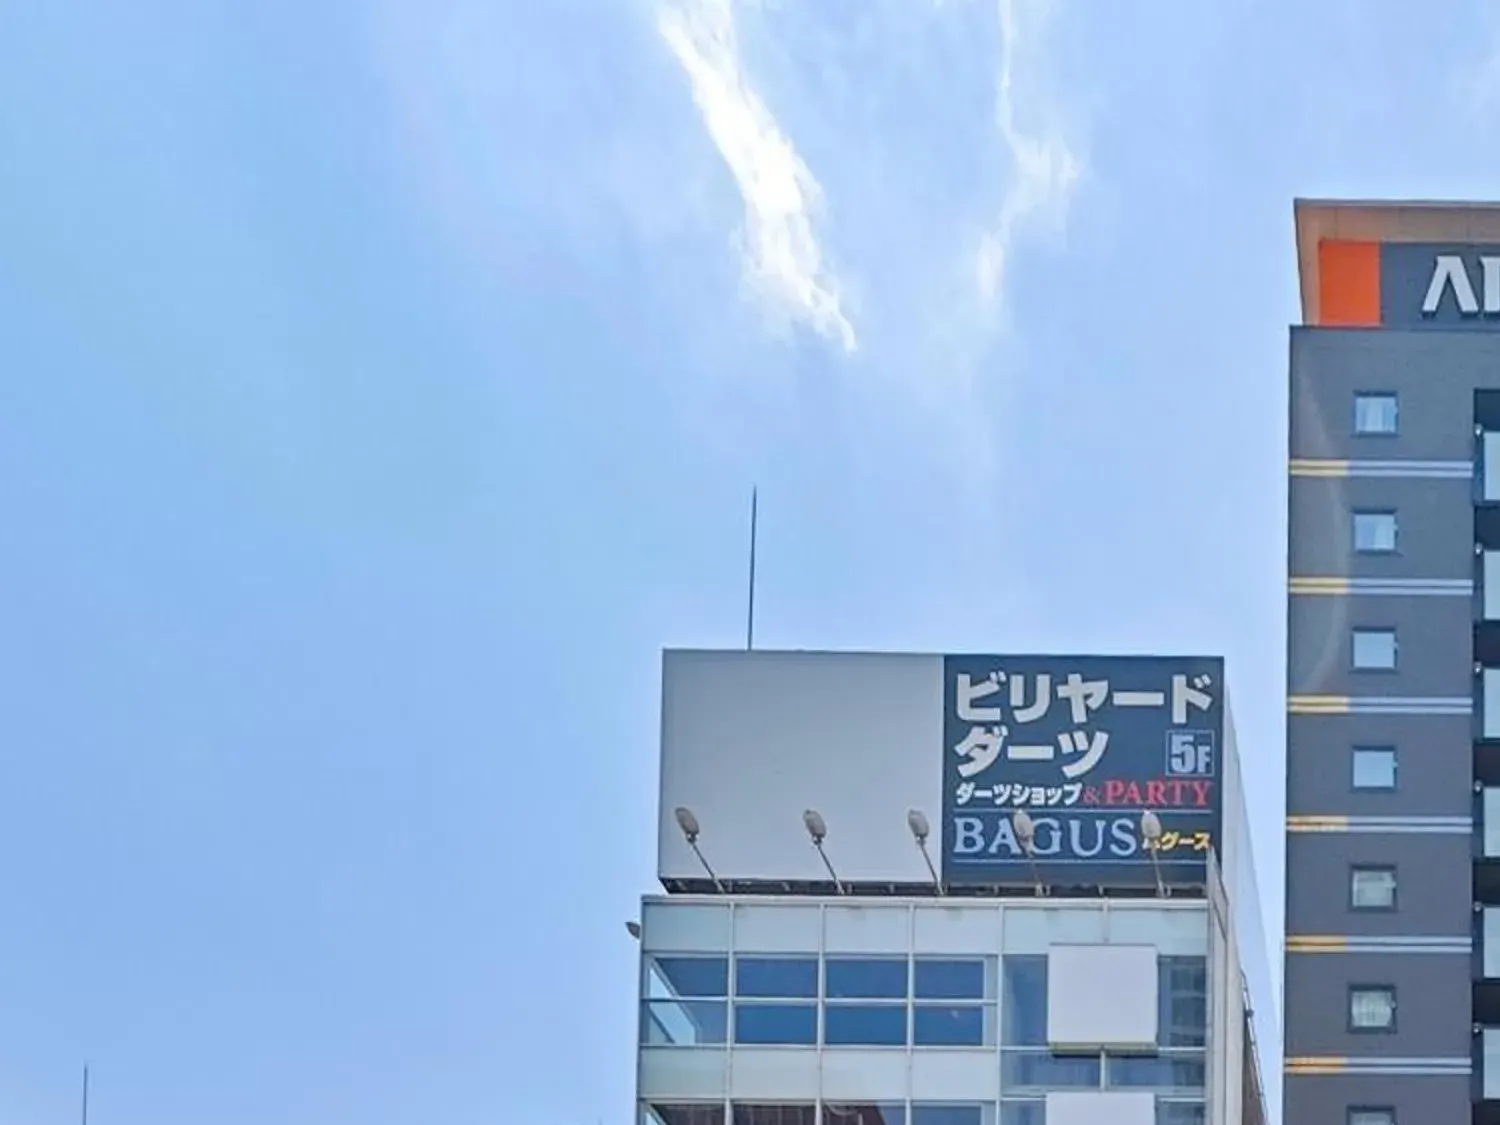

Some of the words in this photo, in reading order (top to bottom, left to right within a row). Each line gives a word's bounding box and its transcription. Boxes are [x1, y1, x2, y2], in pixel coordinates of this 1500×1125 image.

[956, 671, 1213, 724] ビリヤード
[954, 726, 1109, 778] ダーツ
[1170, 733, 1211, 774] 5F
[956, 782, 1083, 806] ダーツショップ
[1104, 780, 1214, 806] PARTY
[953, 816, 1138, 857] BAGUS
